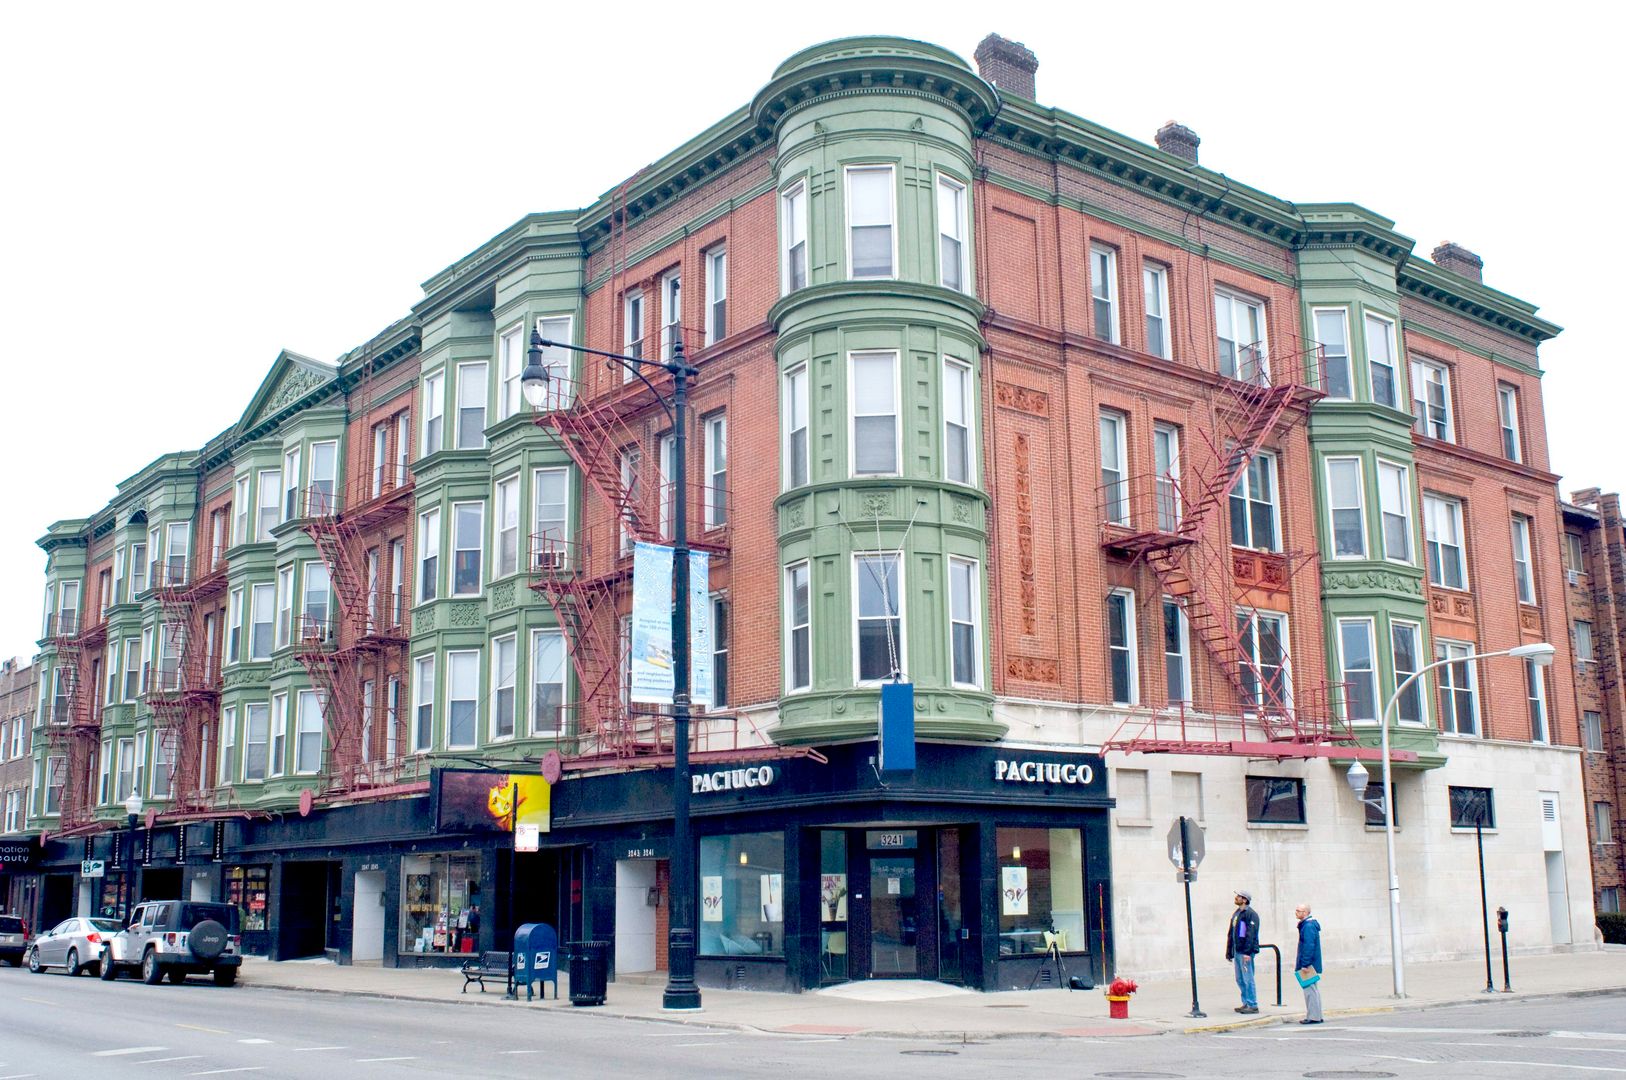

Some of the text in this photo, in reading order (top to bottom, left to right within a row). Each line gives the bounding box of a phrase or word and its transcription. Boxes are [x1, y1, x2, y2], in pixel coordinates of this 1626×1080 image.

[692, 765, 774, 794] PACIUGO
[995, 760, 1093, 785] PACIUGO
[882, 834, 902, 846] 3241
[202, 936, 219, 944] Jeep
